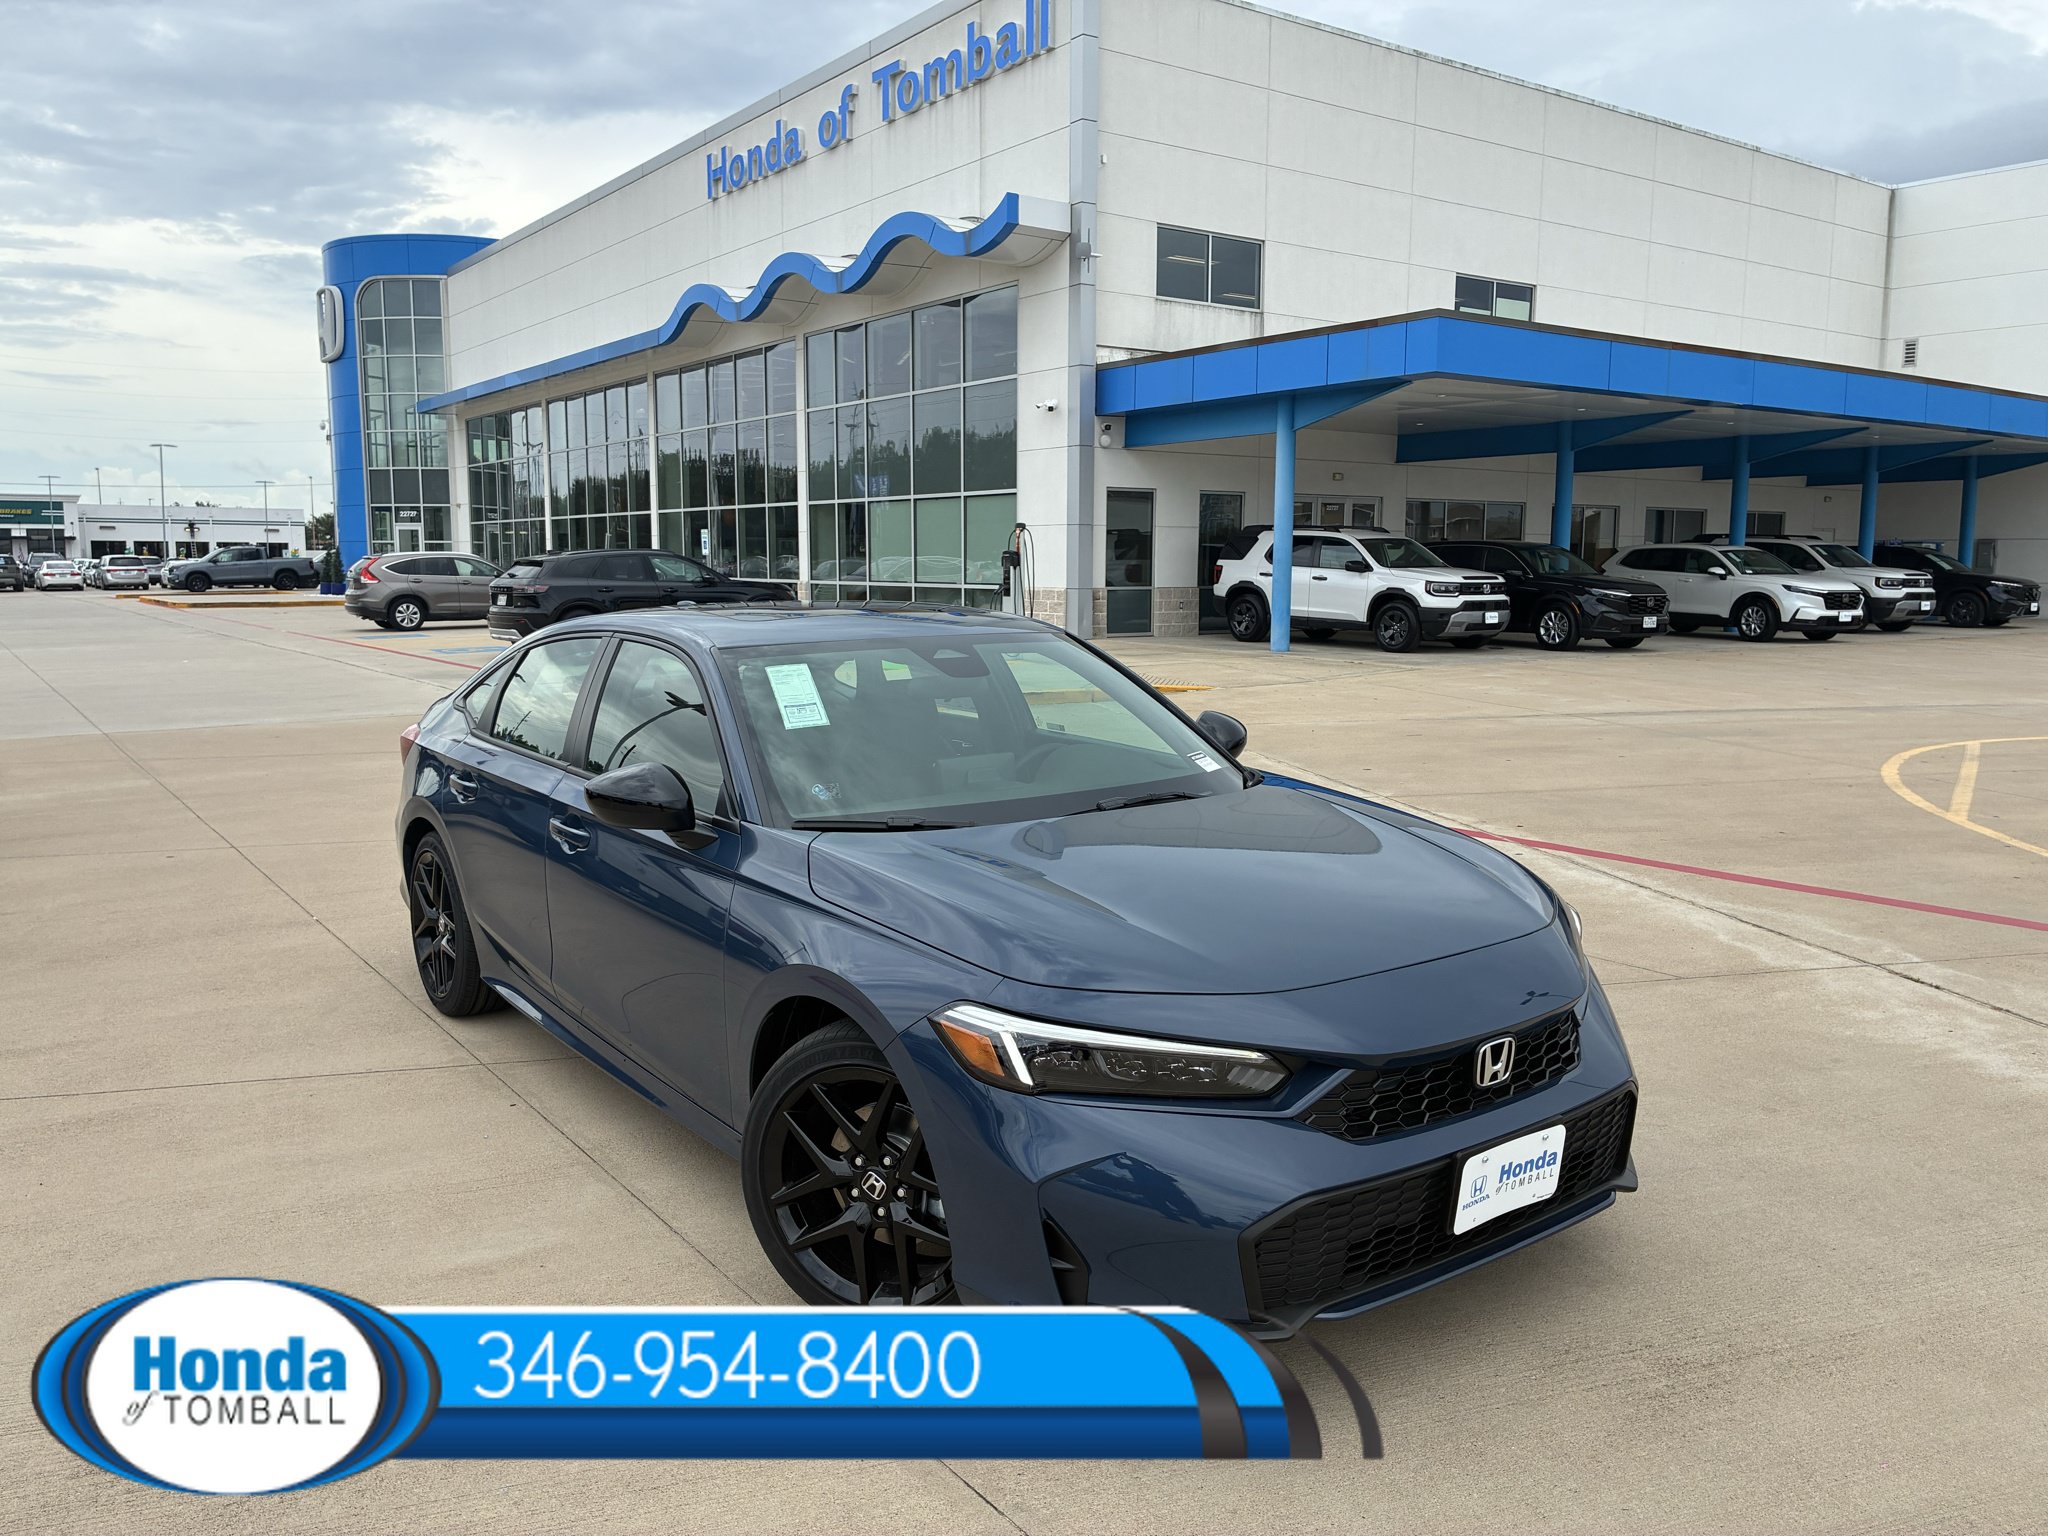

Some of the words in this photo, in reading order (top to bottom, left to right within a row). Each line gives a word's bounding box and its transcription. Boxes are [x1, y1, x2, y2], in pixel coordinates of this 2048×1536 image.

[706, 118, 808, 200] Honda
[818, 83, 859, 149] of
[871, 0, 1055, 124] Tomball
[1498, 1149, 1558, 1184] Honda
[1504, 1168, 1554, 1192] TOMBALL
[1462, 1193, 1490, 1211] HONDA
